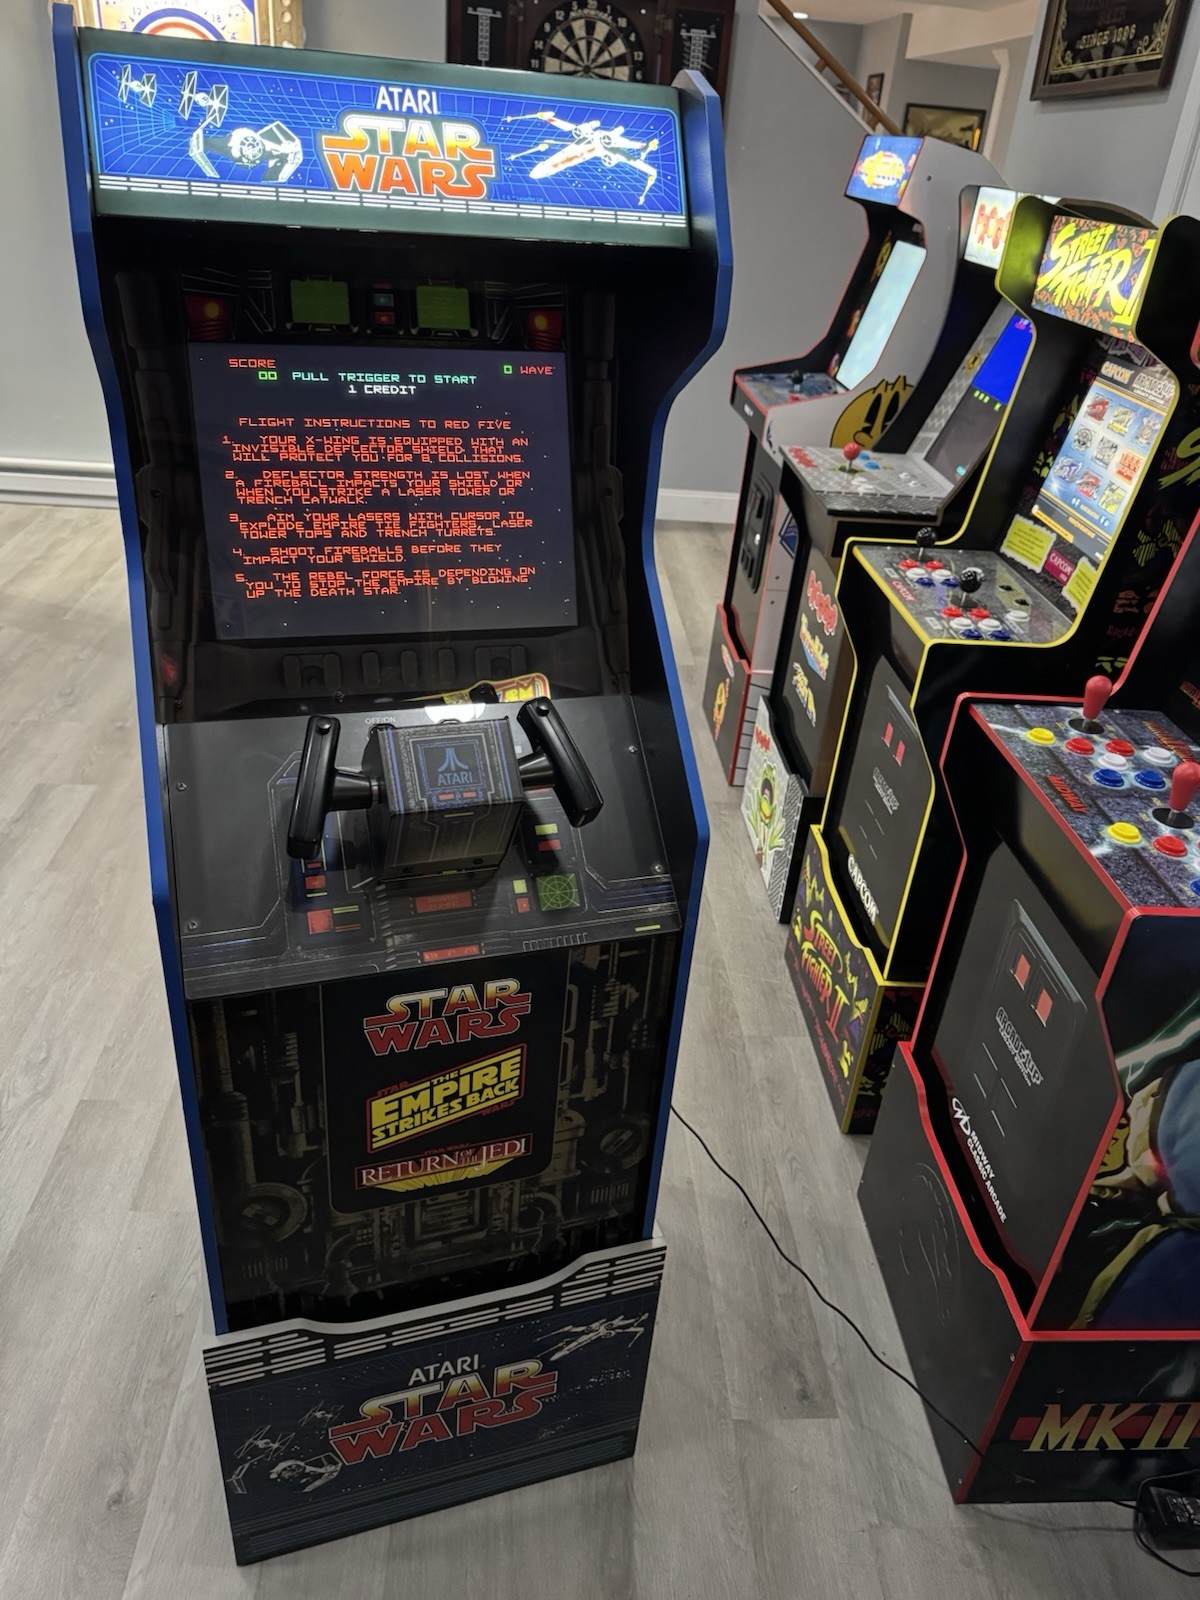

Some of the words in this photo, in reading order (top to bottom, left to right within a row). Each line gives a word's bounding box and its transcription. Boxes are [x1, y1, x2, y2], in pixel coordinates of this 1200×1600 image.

[376, 85, 440, 115] ATARI
[322, 114, 493, 161] STAR
[325, 151, 496, 199] WARS
[229, 358, 276, 368] SCORE
[520, 366, 553, 375] WAVE
[292, 372, 329, 381] PULL
[338, 372, 400, 382] TRIGGER
[409, 374, 426, 383] TO
[434, 375, 477, 384] START
[348, 385, 357, 394] 1
[364, 385, 416, 394] CREDIT
[238, 417, 295, 427] FLIGHT
[304, 418, 411, 428] INSTRUCTIONS
[419, 420, 437, 428] TO
[444, 420, 470, 429] RED
[478, 420, 511, 430] FIVE
[260, 435, 297, 444] YOUR
[305, 436, 359, 445] X-WING
[369, 436, 386, 445] IS
[394, 436, 462, 446] EQUIPPED
[471, 437, 504, 446] WITH
[512, 438, 528, 446] AN
[232, 444, 315, 453] INVISIBLE
[324, 444, 403, 454] DEFLECTOR
[412, 446, 463, 454] SHIELD
[472, 446, 504, 454] THAT
[232, 453, 270, 462] WILL
[280, 453, 342, 462] PROTECT
[353, 453, 378, 462] YOU
[387, 454, 413, 462] FOR
[438, 454, 524, 463] COLLISIONS.
[225, 471, 238, 479] 2.
[262, 471, 344, 479] DEFLECTOR
[354, 471, 423, 479] STRENGTH
[431, 471, 448, 479] IS
[456, 471, 489, 479] LOST
[498, 471, 531, 479] WHEN
[235, 480, 245, 488] A
[254, 480, 328, 488] FIREBALL
[336, 480, 398, 488] IMPACTS
[406, 480, 440, 488] YOUR
[449, 480, 499, 488] SHIELD
[506, 480, 523, 488] OR
[236, 488, 274, 496] WHEN
[282, 488, 310, 496] YOU
[319, 488, 372, 496] STRIKE
[380, 488, 390, 496] A
[398, 488, 441, 496] LASER
[449, 488, 490, 496] TOWER
[498, 488, 515, 496] OR
[237, 496, 293, 504] TRENCH
[302, 496, 368, 504] CATWALK.
[229, 514, 242, 522] 3.
[267, 513, 294, 522] AIM
[304, 513, 339, 522] YOUR
[348, 513, 400, 521] LASERS
[408, 512, 443, 520] WITH
[451, 512, 500, 520] CURSOR
[508, 511, 524, 519] TO
[240, 522, 305, 531] EXPLODE
[313, 522, 366, 530] EMPIRE
[376, 521, 400, 529] TIE
[493, 520, 533, 528] LASER
[240, 531, 287, 539] TOWER
[296, 530, 332, 538] TOPS
[341, 530, 367, 538] AND
[376, 529, 428, 538] TRENCH
[436, 528, 496, 537] TURRETS.
[232, 548, 245, 556] 4.
[270, 547, 315, 556] SHOOT
[324, 546, 403, 555] FIREBALLS
[411, 545, 462, 554] BEFORE
[470, 544, 502, 552] THEY
[243, 556, 298, 565] IMPACT
[307, 556, 343, 564] YOUR
[352, 555, 407, 563] SHIELD.
[235, 573, 248, 582] 5.
[273, 572, 300, 581] THE
[309, 572, 353, 580] REBEL
[362, 570, 404, 579] FORCE
[413, 569, 430, 578] IS
[438, 568, 511, 577] DEPENDING
[519, 567, 536, 575] ON
[246, 582, 274, 590] YOU
[283, 581, 300, 589] TO
[310, 580, 345, 589] STOP
[354, 579, 381, 588] THE
[389, 578, 439, 586] EMPIRE
[447, 577, 463, 585] BY
[472, 575, 528, 584] BLOWING
[246, 590, 265, 599] UP
[275, 589, 301, 598] THE
[310, 588, 355, 597] DEATH
[364, 587, 402, 595] STAR.
[437, 771, 474, 787] ATARI
[1047, 773, 1090, 814] MIDWAY
[847, 853, 880, 927] CAPCOM
[363, 978, 532, 1028] STAR
[364, 1004, 532, 1056] WARS
[431, 1070, 460, 1086] THE
[371, 1055, 521, 1127] EMPIRE
[371, 1098, 463, 1142] STRIKES
[465, 1076, 520, 1108] BACK
[474, 1138, 526, 1171] JEDI
[969, 1130, 996, 1180] MIDWAY
[361, 1152, 460, 1186] RETURN
[985, 1178, 1007, 1224] ARCADE
[407, 1354, 481, 1387] ATARI
[328, 1358, 559, 1439] STAR
[328, 1383, 558, 1466] WARS
